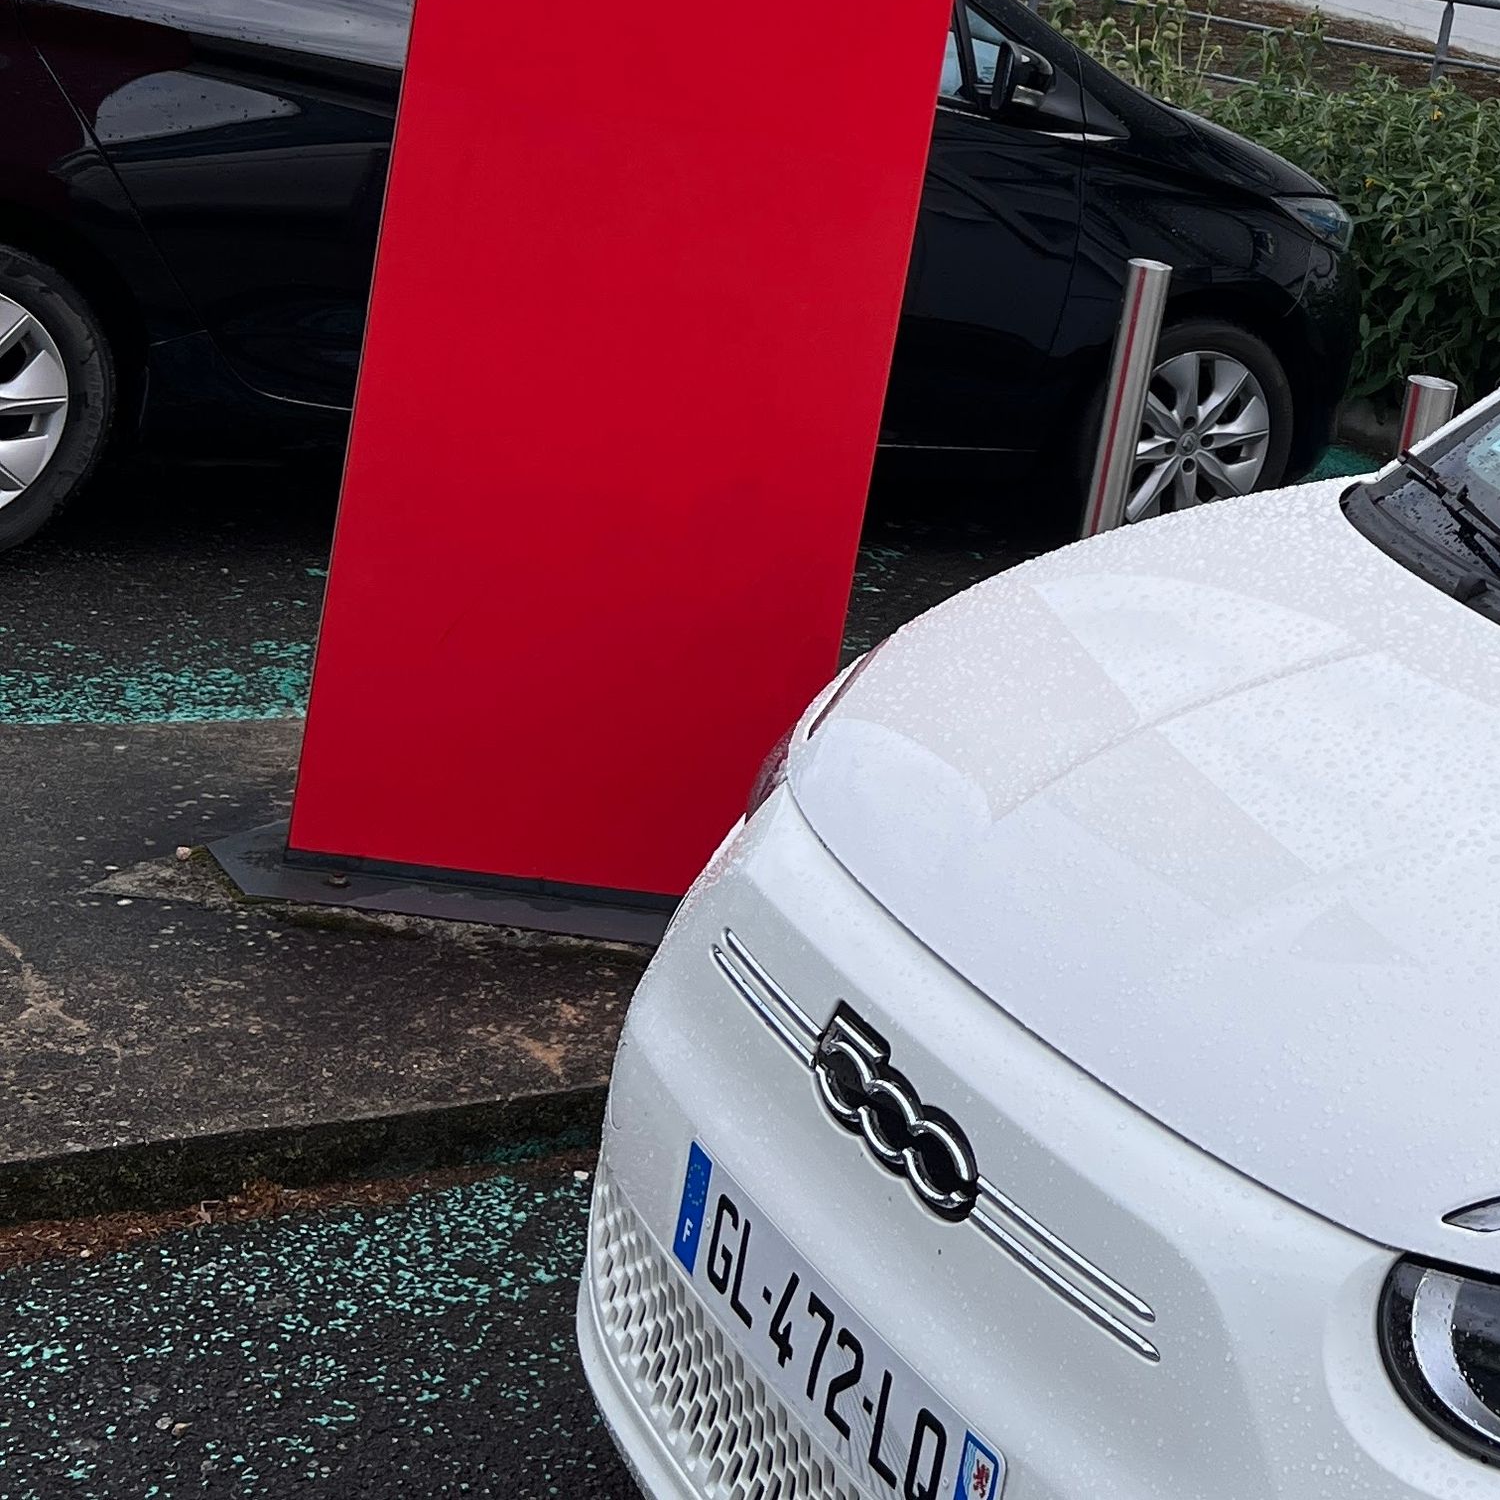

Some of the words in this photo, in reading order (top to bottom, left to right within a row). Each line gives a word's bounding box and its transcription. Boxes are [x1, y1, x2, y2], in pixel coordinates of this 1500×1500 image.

[811, 1000, 978, 1222] 500
[682, 1217, 693, 1242] F
[707, 1193, 946, 1500] GL-472-LQ
